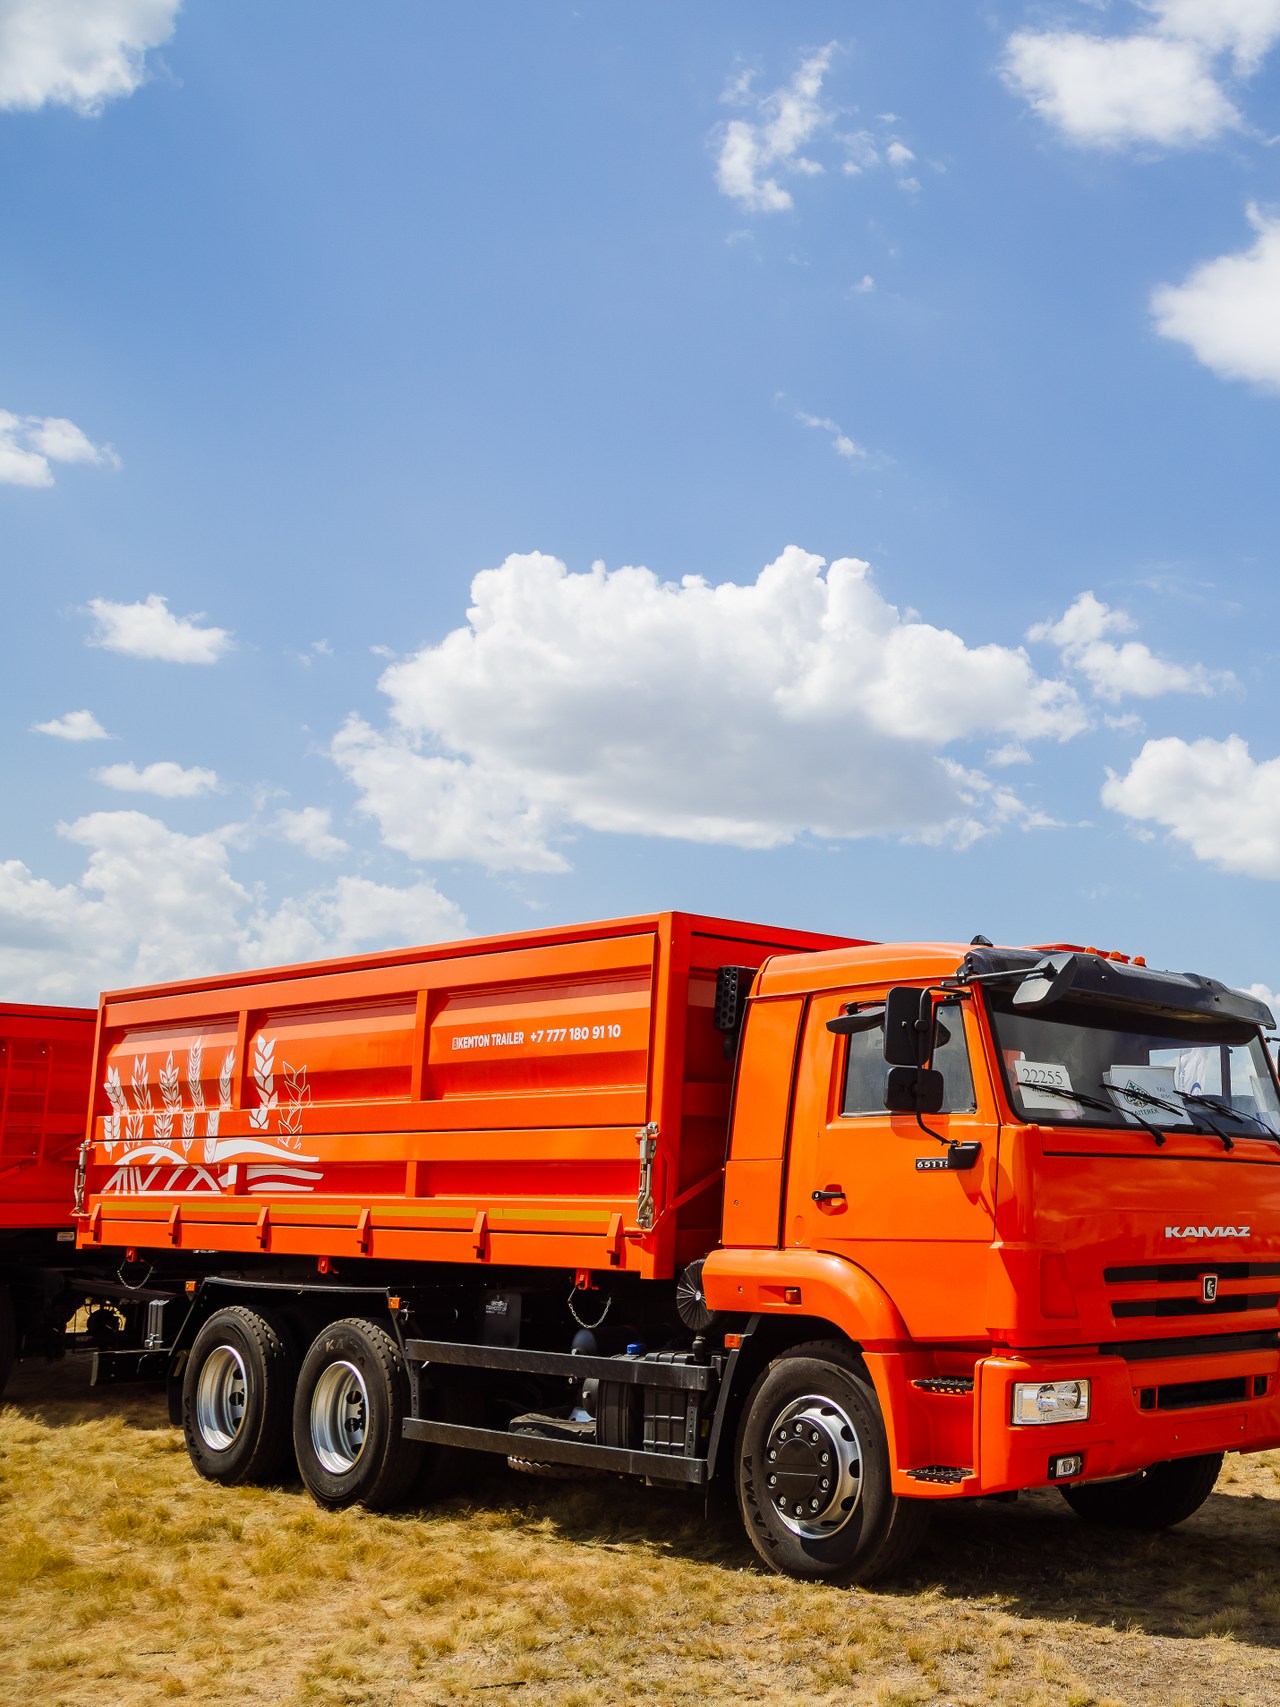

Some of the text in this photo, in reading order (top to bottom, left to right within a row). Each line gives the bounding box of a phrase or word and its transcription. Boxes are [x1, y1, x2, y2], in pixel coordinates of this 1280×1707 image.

[458, 1024, 621, 1050] KEMTON TRAILER +7 777 180 91 10
[1022, 1067, 1064, 1085] 22255
[1165, 1226, 1251, 1238] KAMAZ
